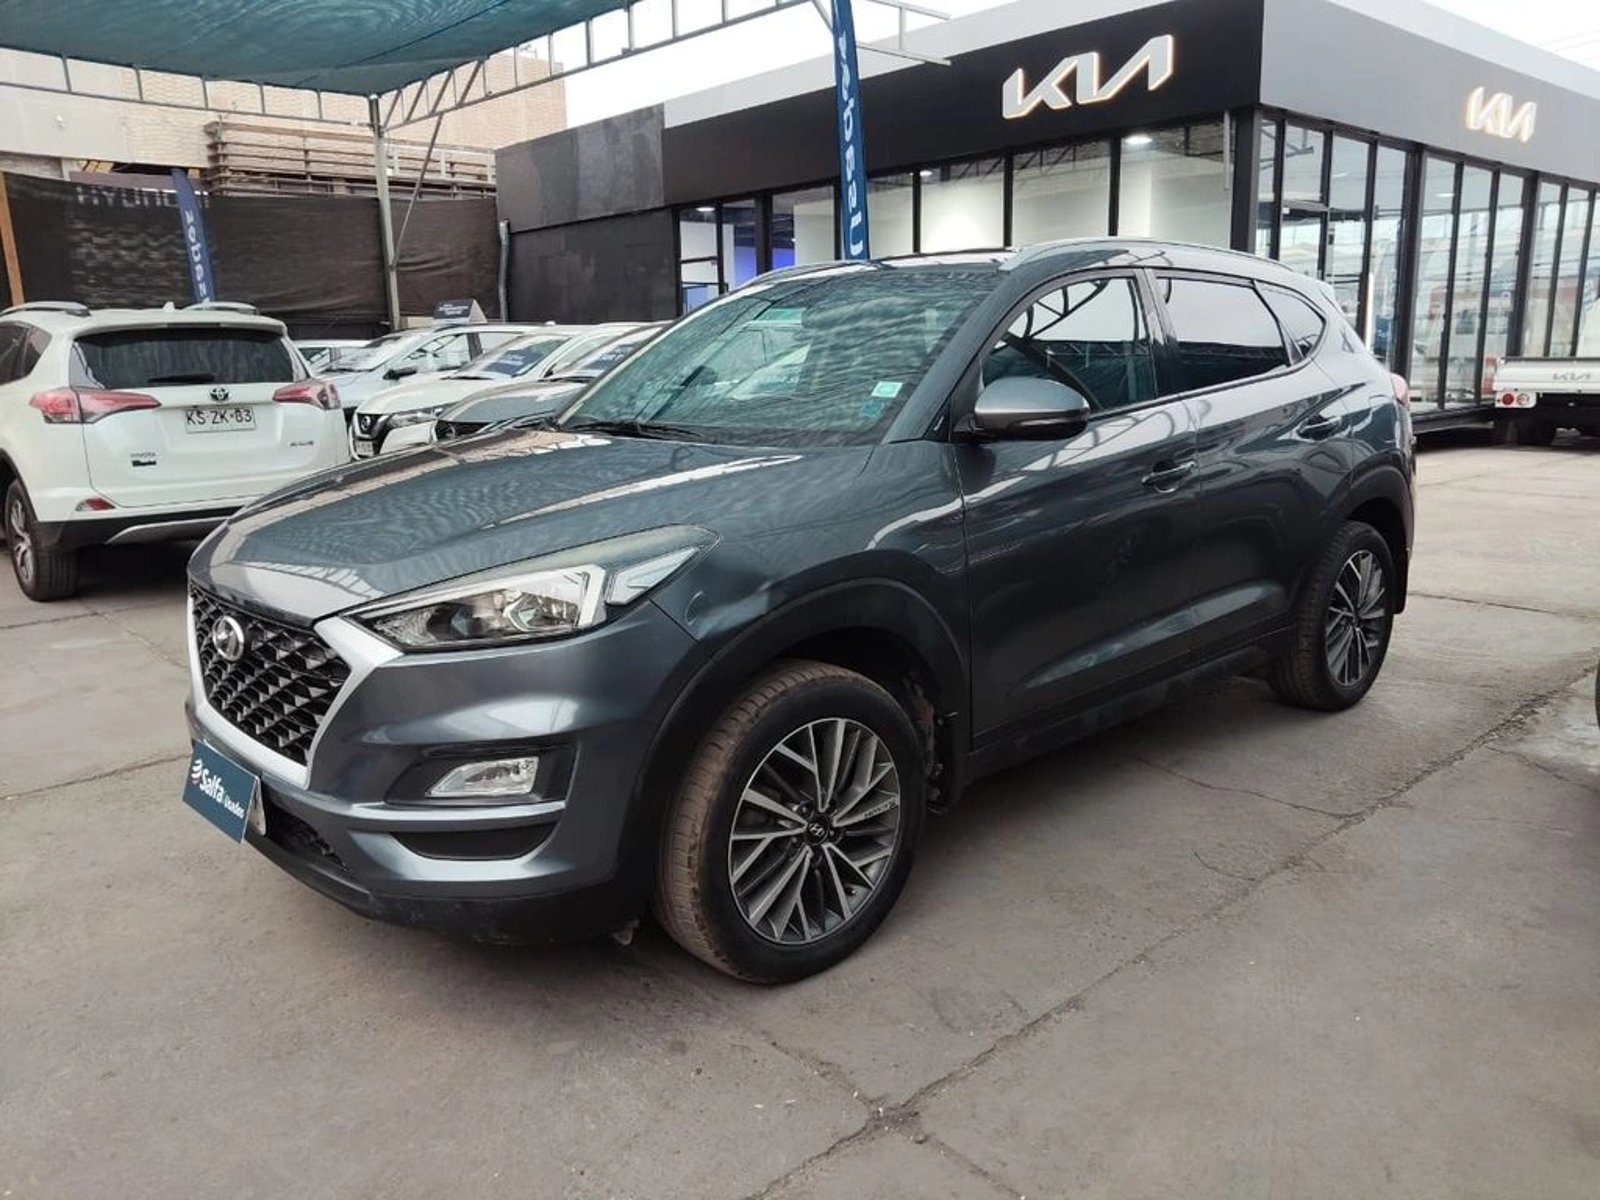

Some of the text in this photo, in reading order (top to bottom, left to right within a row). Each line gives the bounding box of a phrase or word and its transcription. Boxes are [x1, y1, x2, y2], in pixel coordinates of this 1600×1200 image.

[1002, 33, 1175, 119] KIA
[1464, 86, 1538, 143] KIA
[199, 768, 224, 803] Salfa
